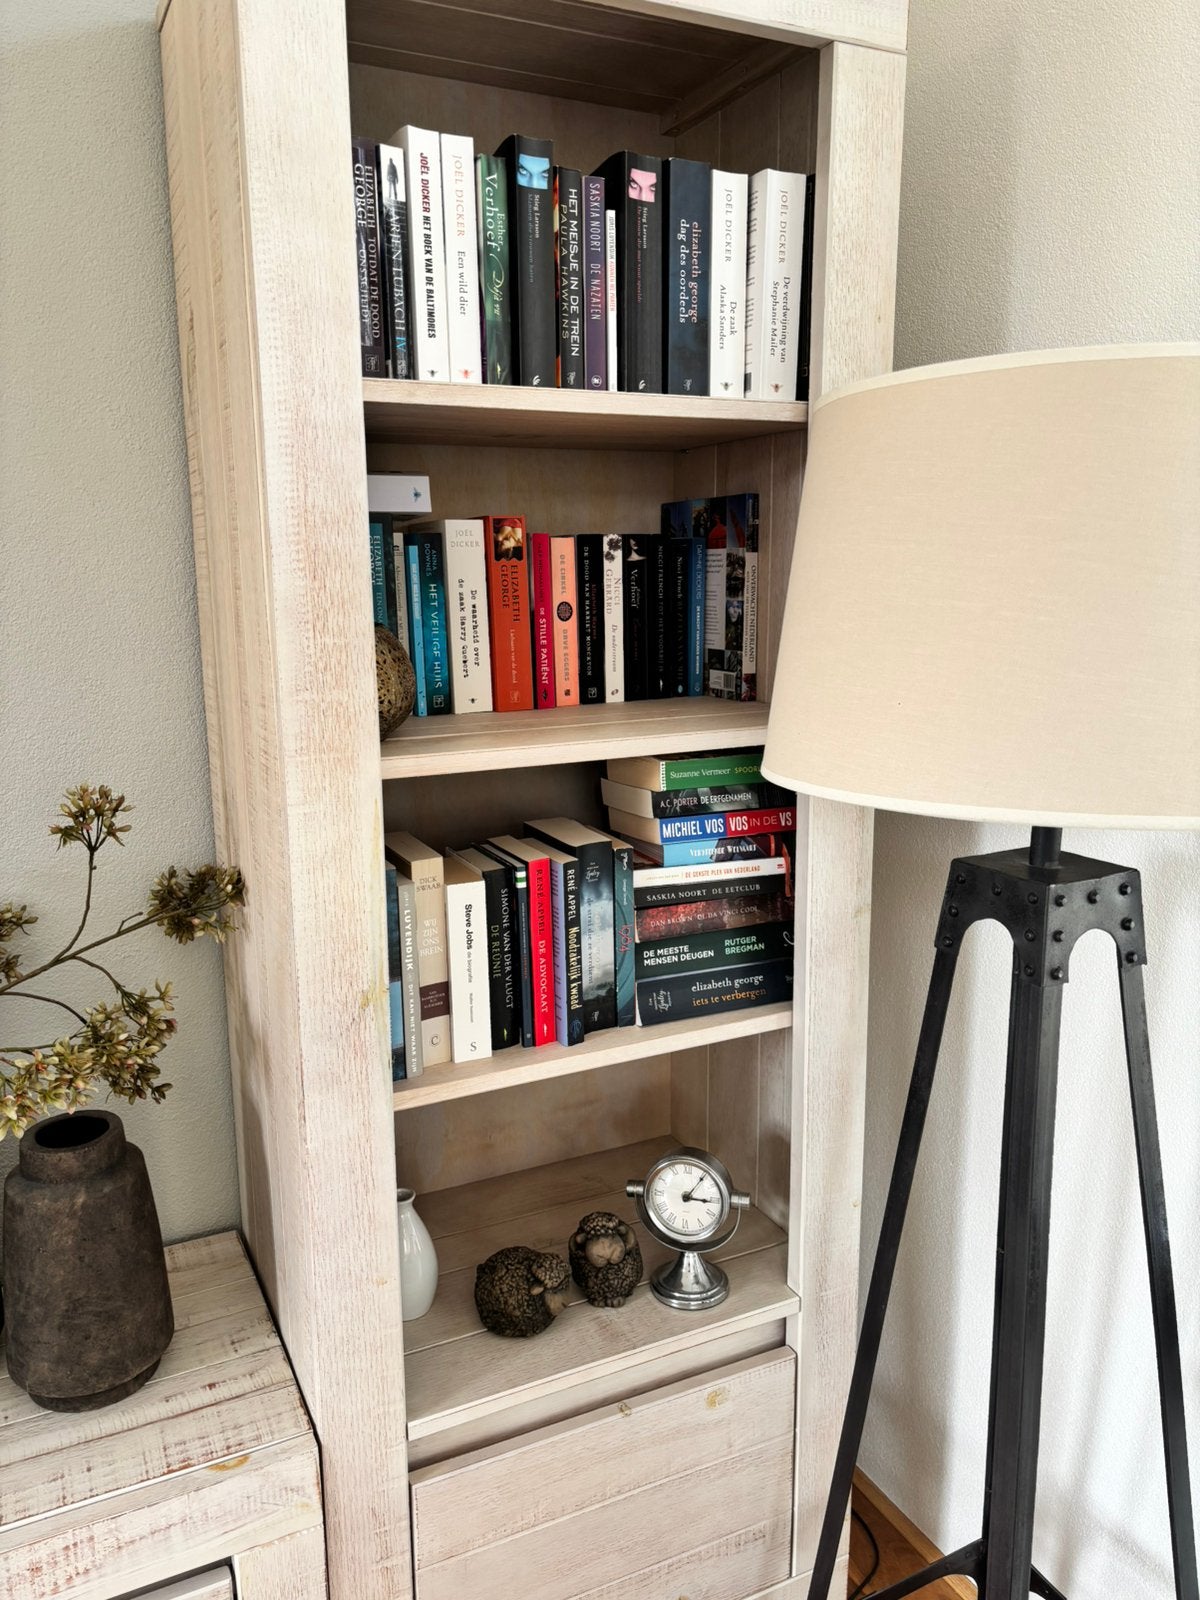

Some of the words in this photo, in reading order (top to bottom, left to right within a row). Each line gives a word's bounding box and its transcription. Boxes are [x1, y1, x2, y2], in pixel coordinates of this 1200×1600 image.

[420, 152, 431, 175] JOËL
[452, 155, 463, 184] JOËL
[354, 164, 367, 227] GEORGE
[421, 178, 431, 212] DICKER
[568, 189, 578, 216] HET
[589, 183, 601, 217] SASKIA
[780, 190, 789, 216] JOËL
[423, 216, 431, 231] HET
[456, 190, 465, 237] DICKER
[485, 173, 500, 251] Verhoef
[390, 213, 402, 261] ARJEN
[496, 213, 505, 246] Esther
[560, 204, 568, 256] PAULA
[590, 221, 601, 252] NOORT
[678, 219, 689, 240] dag
[724, 220, 732, 263] DICKER
[778, 221, 787, 264] DICKER
[365, 166, 376, 228] ELIZABETH
[371, 303, 380, 338] DOOD
[424, 233, 432, 255] BOEK
[569, 221, 578, 271] MEISJE
[680, 245, 689, 265] des
[691, 222, 701, 278] elizabeth
[425, 258, 433, 273] VAN
[457, 250, 466, 269] Een
[590, 264, 601, 274] DE
[426, 276, 434, 287] DE
[458, 273, 467, 294] wild
[570, 277, 579, 290] IN
[783, 277, 791, 289] De
[392, 267, 405, 331] LUBACH
[458, 298, 467, 315] dier
[561, 266, 570, 340] HAWKINS
[570, 296, 579, 314] DE
[590, 279, 601, 320] NAZATEN
[679, 270, 689, 323] oordeels
[689, 282, 699, 323] george
[719, 285, 727, 314] Alaska
[730, 301, 737, 313] De
[770, 281, 780, 325] Stephanie
[426, 289, 436, 338] BALTIMORES
[730, 316, 738, 335] zaak
[779, 292, 790, 345] verdwijning
[395, 336, 406, 352] IV
[570, 319, 580, 356] TREIN
[719, 316, 727, 350] Sanders
[770, 328, 778, 357] Mailer
[450, 540, 480, 548] DICKER
[373, 535, 383, 585] ELIZABETH
[424, 543, 432, 577] DOWNES
[430, 550, 438, 571] ANNA
[560, 554, 565, 566] DE
[429, 584, 437, 607] HET
[458, 579, 465, 591] de
[470, 590, 478, 600] De
[500, 565, 510, 609] GEORGE
[510, 565, 520, 622] ELIZABETH
[605, 569, 613, 615] GERRARD
[630, 569, 640, 608] Verhoef
[430, 612, 440, 657] VEILIGE
[471, 604, 480, 644] waarheid
[461, 645, 469, 678] Quebert
[473, 647, 481, 667] over
[541, 648, 549, 684] PATIËNT
[433, 661, 442, 688] HUIS
[670, 771, 700, 779] Suzanne
[701, 768, 731, 776] Vermeer
[673, 796, 698, 806] PORTER
[701, 795, 710, 804] DE
[710, 793, 752, 804] ERFGENAMEN
[662, 821, 702, 838] MICHIEL
[705, 818, 724, 834] VOS
[729, 816, 748, 831] VOS
[750, 818, 760, 827] IN
[763, 816, 777, 825] DE
[779, 812, 792, 826] VS
[536, 869, 544, 898] RENÉ
[567, 869, 576, 892] RENÉ
[647, 893, 676, 901] SASKIA
[679, 889, 707, 898] NOORT
[712, 887, 723, 895] DE
[725, 884, 760, 894] EETCLUB
[465, 904, 473, 927] Steve
[500, 888, 510, 928] SIMONE
[537, 902, 545, 935] APPEL
[567, 894, 577, 920] APPEL
[667, 915, 692, 924] BROWN
[404, 909, 414, 970] LUYENDIJK
[466, 929, 474, 950] Jobs
[490, 925, 500, 938] DE
[503, 931, 511, 951] VAN
[619, 924, 633, 952] 1984
[724, 936, 757, 946] RUTGER
[539, 940, 546, 954] DE
[568, 927, 580, 980] Noodzakelijk
[643, 950, 655, 958] DE
[657, 945, 689, 955] MEESTE
[643, 957, 678, 966] MENSEN
[681, 950, 714, 962] DEUGEN
[725, 943, 764, 955] BREGMAN
[504, 954, 512, 973] DER
[505, 976, 513, 1009] VLUGT
[540, 958, 548, 1013] ADVOCAAT
[571, 983, 581, 1010] kwaad
[691, 978, 732, 993] elizabeth
[734, 974, 764, 988] george
[692, 997, 709, 1007] iets
[711, 996, 719, 1004] te
[721, 988, 766, 1001] verbergen
